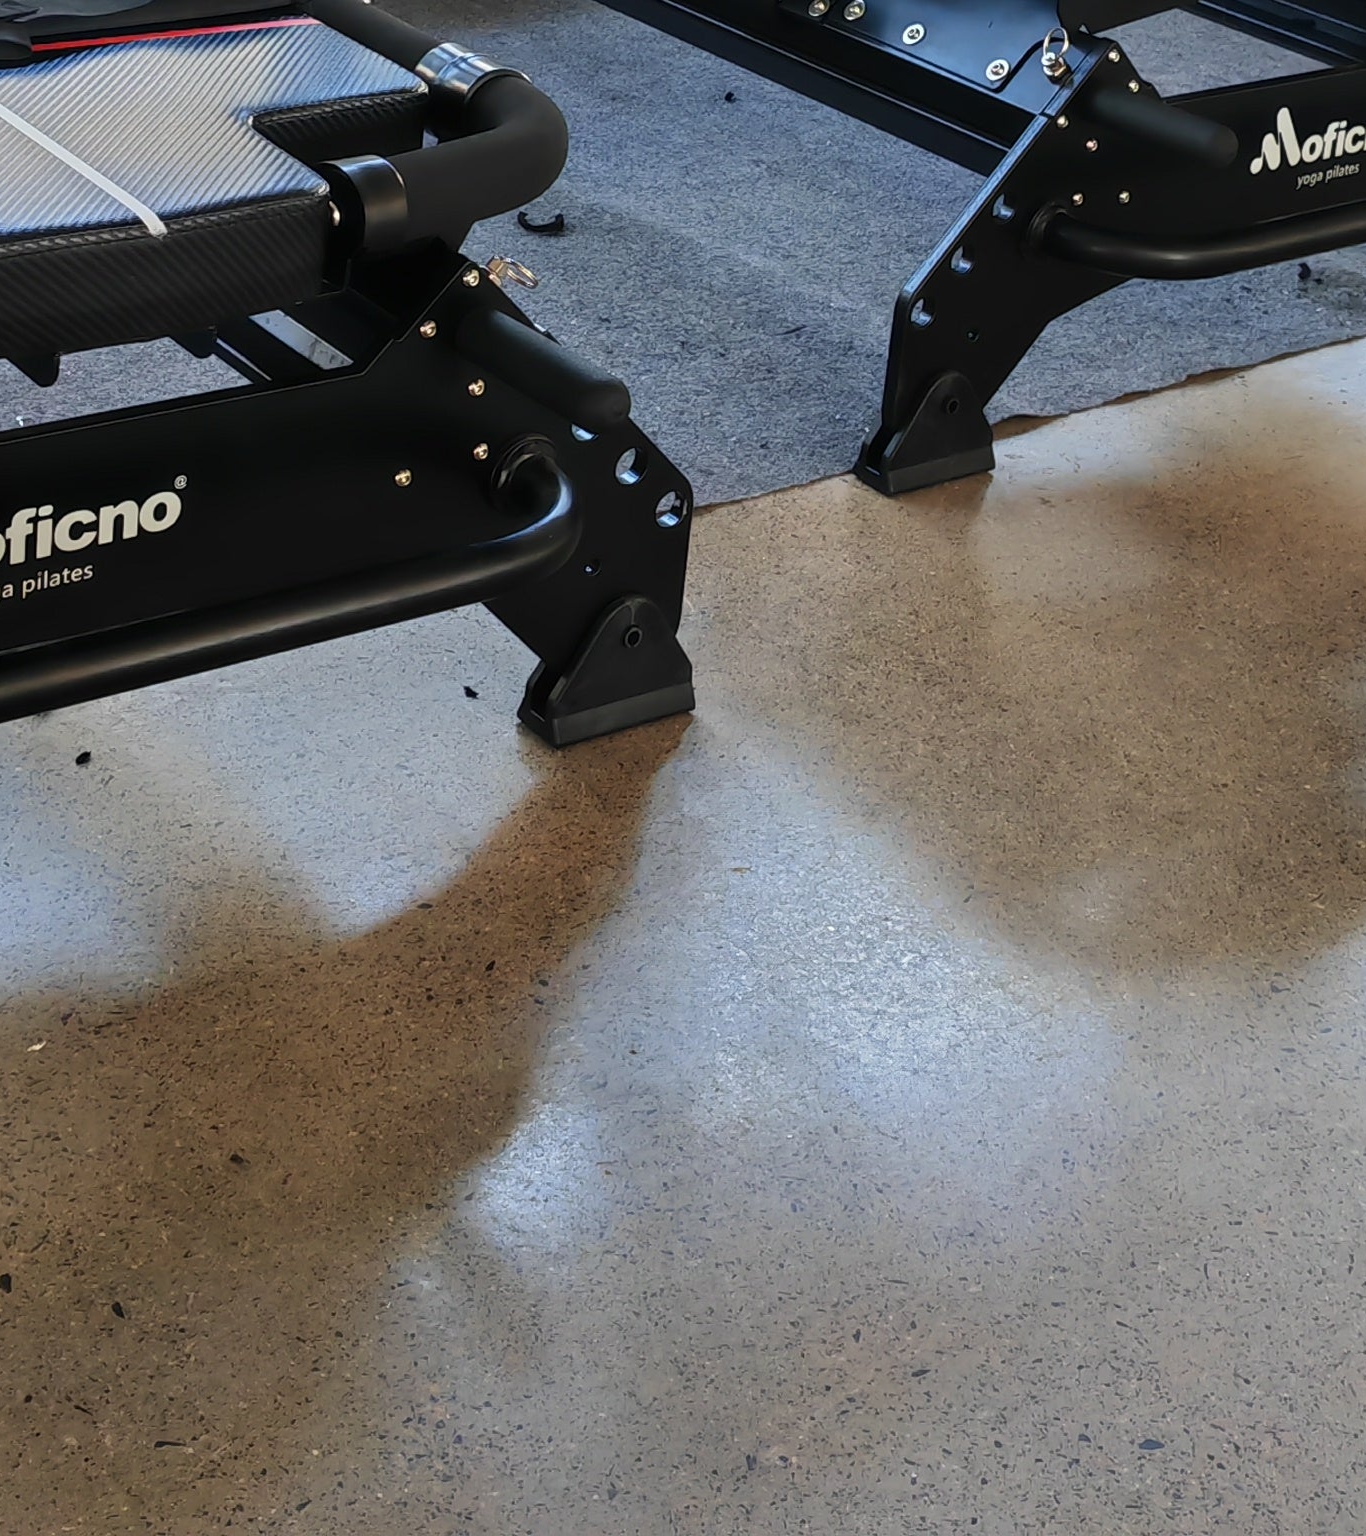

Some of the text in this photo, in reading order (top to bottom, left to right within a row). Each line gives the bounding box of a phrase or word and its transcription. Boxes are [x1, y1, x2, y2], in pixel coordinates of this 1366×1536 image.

[1296, 162, 1360, 190] yoga pilates
[22, 563, 94, 599] pilates
